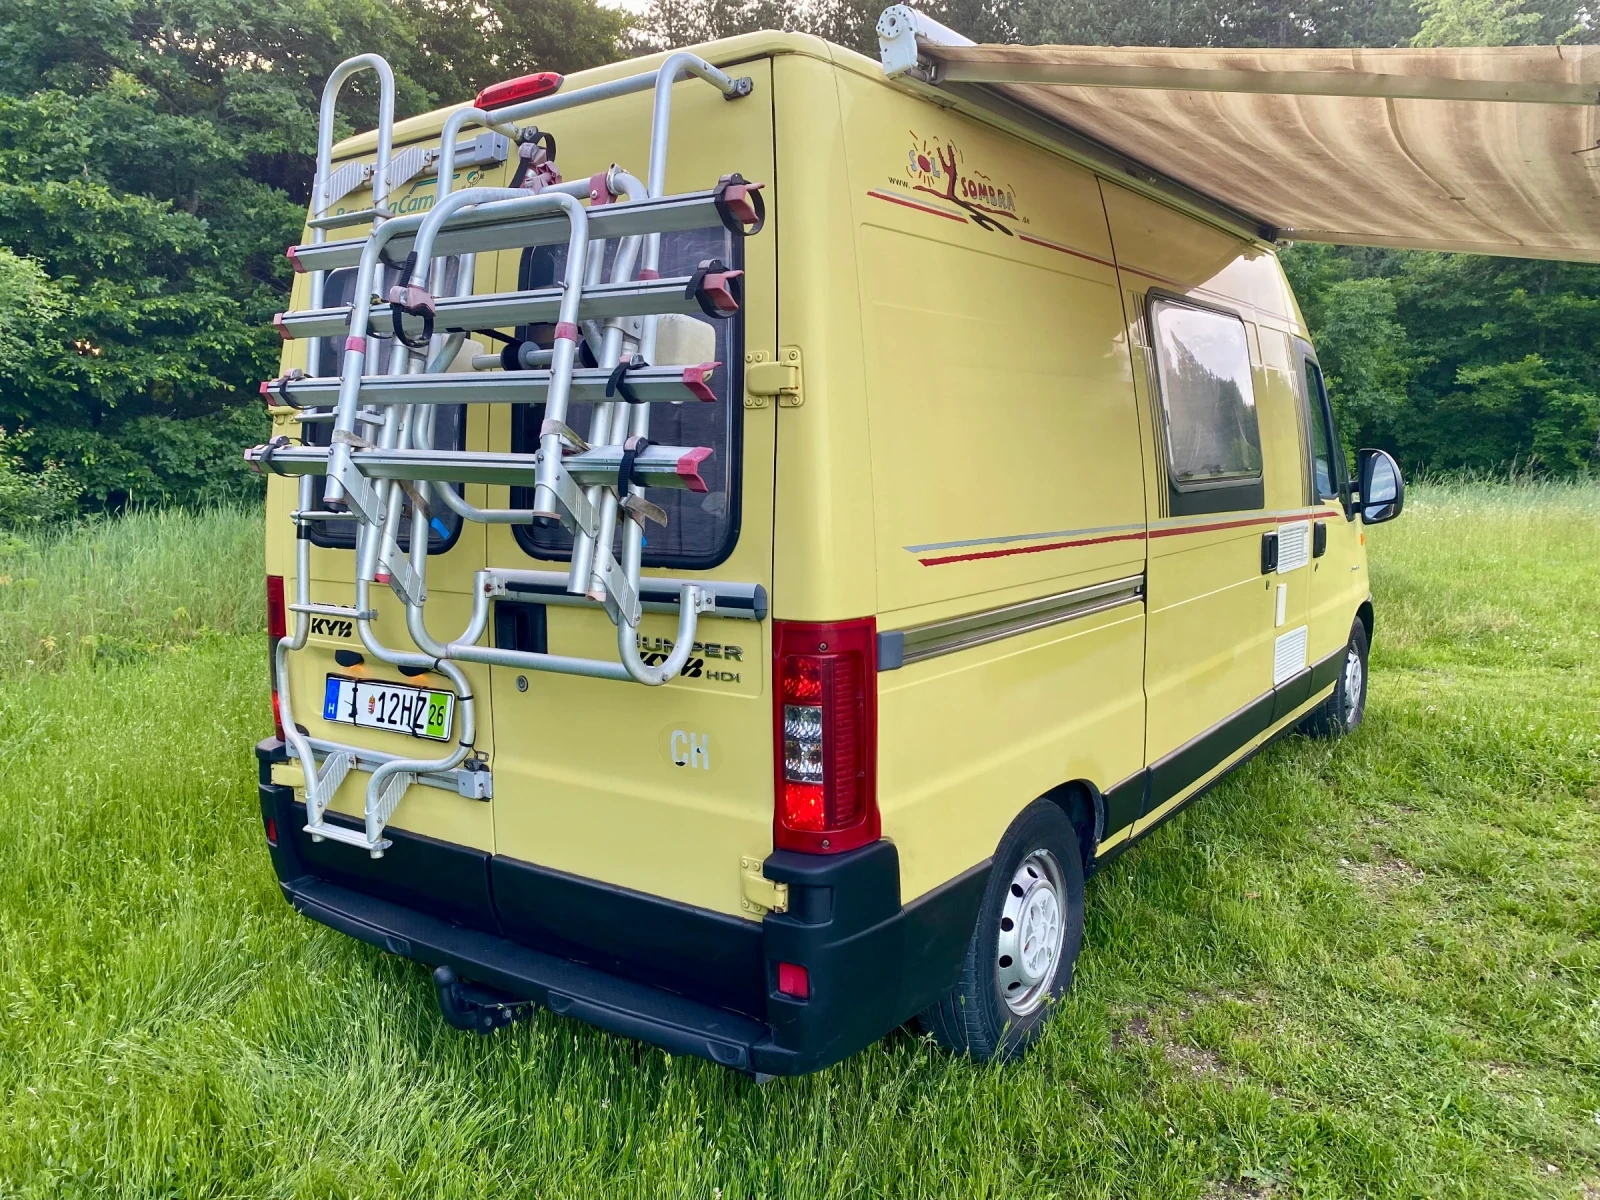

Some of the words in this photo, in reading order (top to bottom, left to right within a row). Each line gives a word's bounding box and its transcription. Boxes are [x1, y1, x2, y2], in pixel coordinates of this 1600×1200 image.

[961, 176, 1016, 212] SOMBRA
[311, 617, 353, 638] KYB
[376, 691, 427, 730] 12HZ
[428, 703, 445, 727] 26
[670, 729, 710, 771] CH
